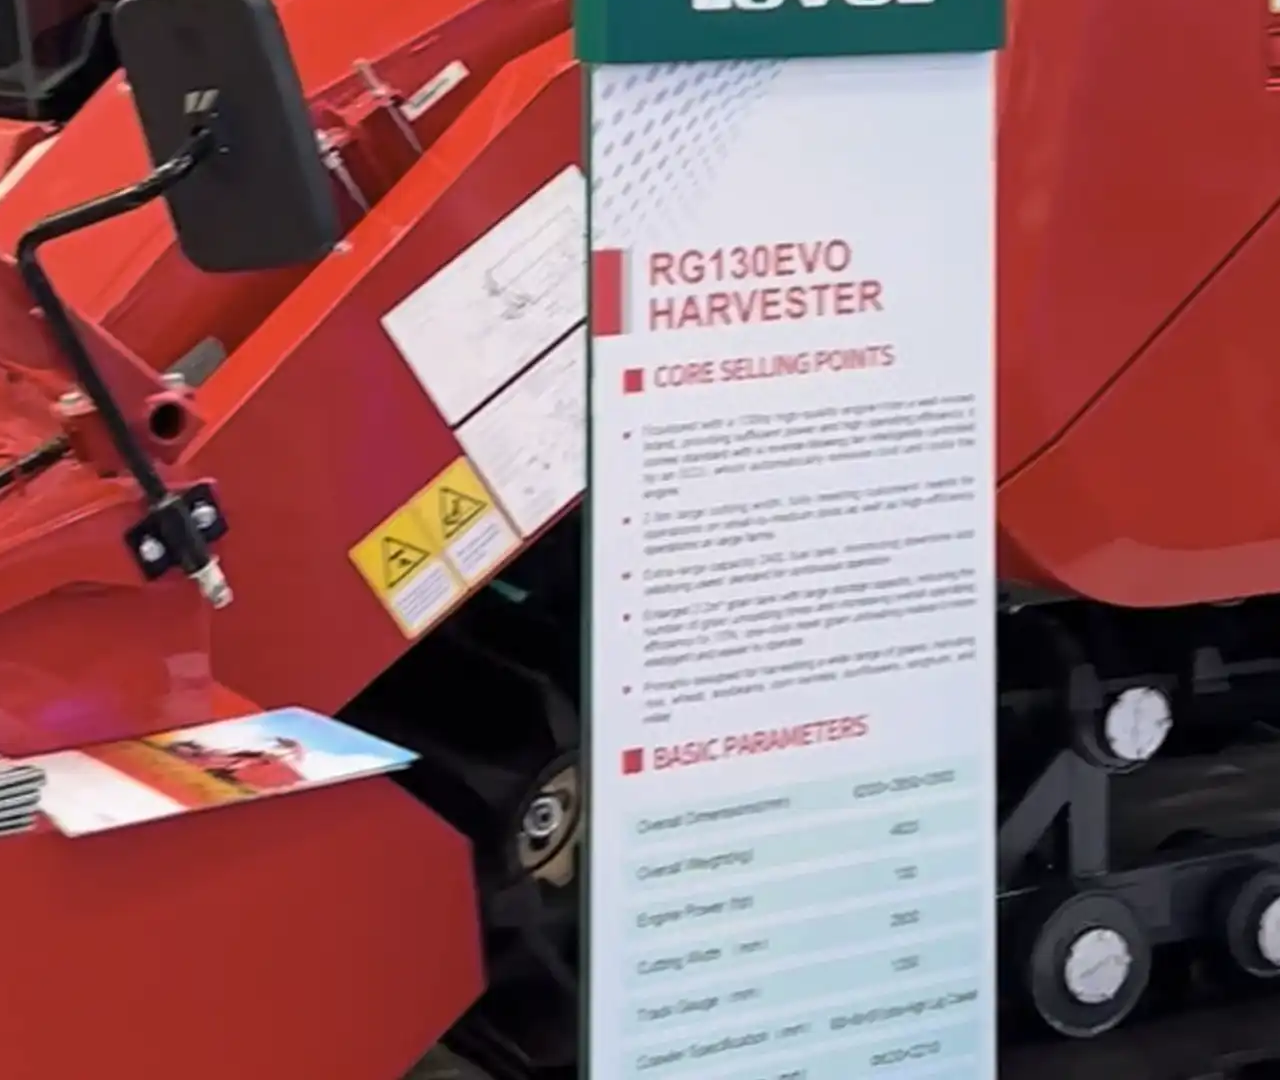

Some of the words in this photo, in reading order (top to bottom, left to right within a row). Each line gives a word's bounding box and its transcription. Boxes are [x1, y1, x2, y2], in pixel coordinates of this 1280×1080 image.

[649, 238, 852, 286] RG130EVO
[649, 279, 884, 331] HARVESTER
[654, 361, 714, 388] CORE
[720, 352, 809, 382] SELLING
[816, 344, 895, 372] POINTS
[654, 738, 719, 770] BASIC
[723, 714, 870, 756] PARAMETERS
